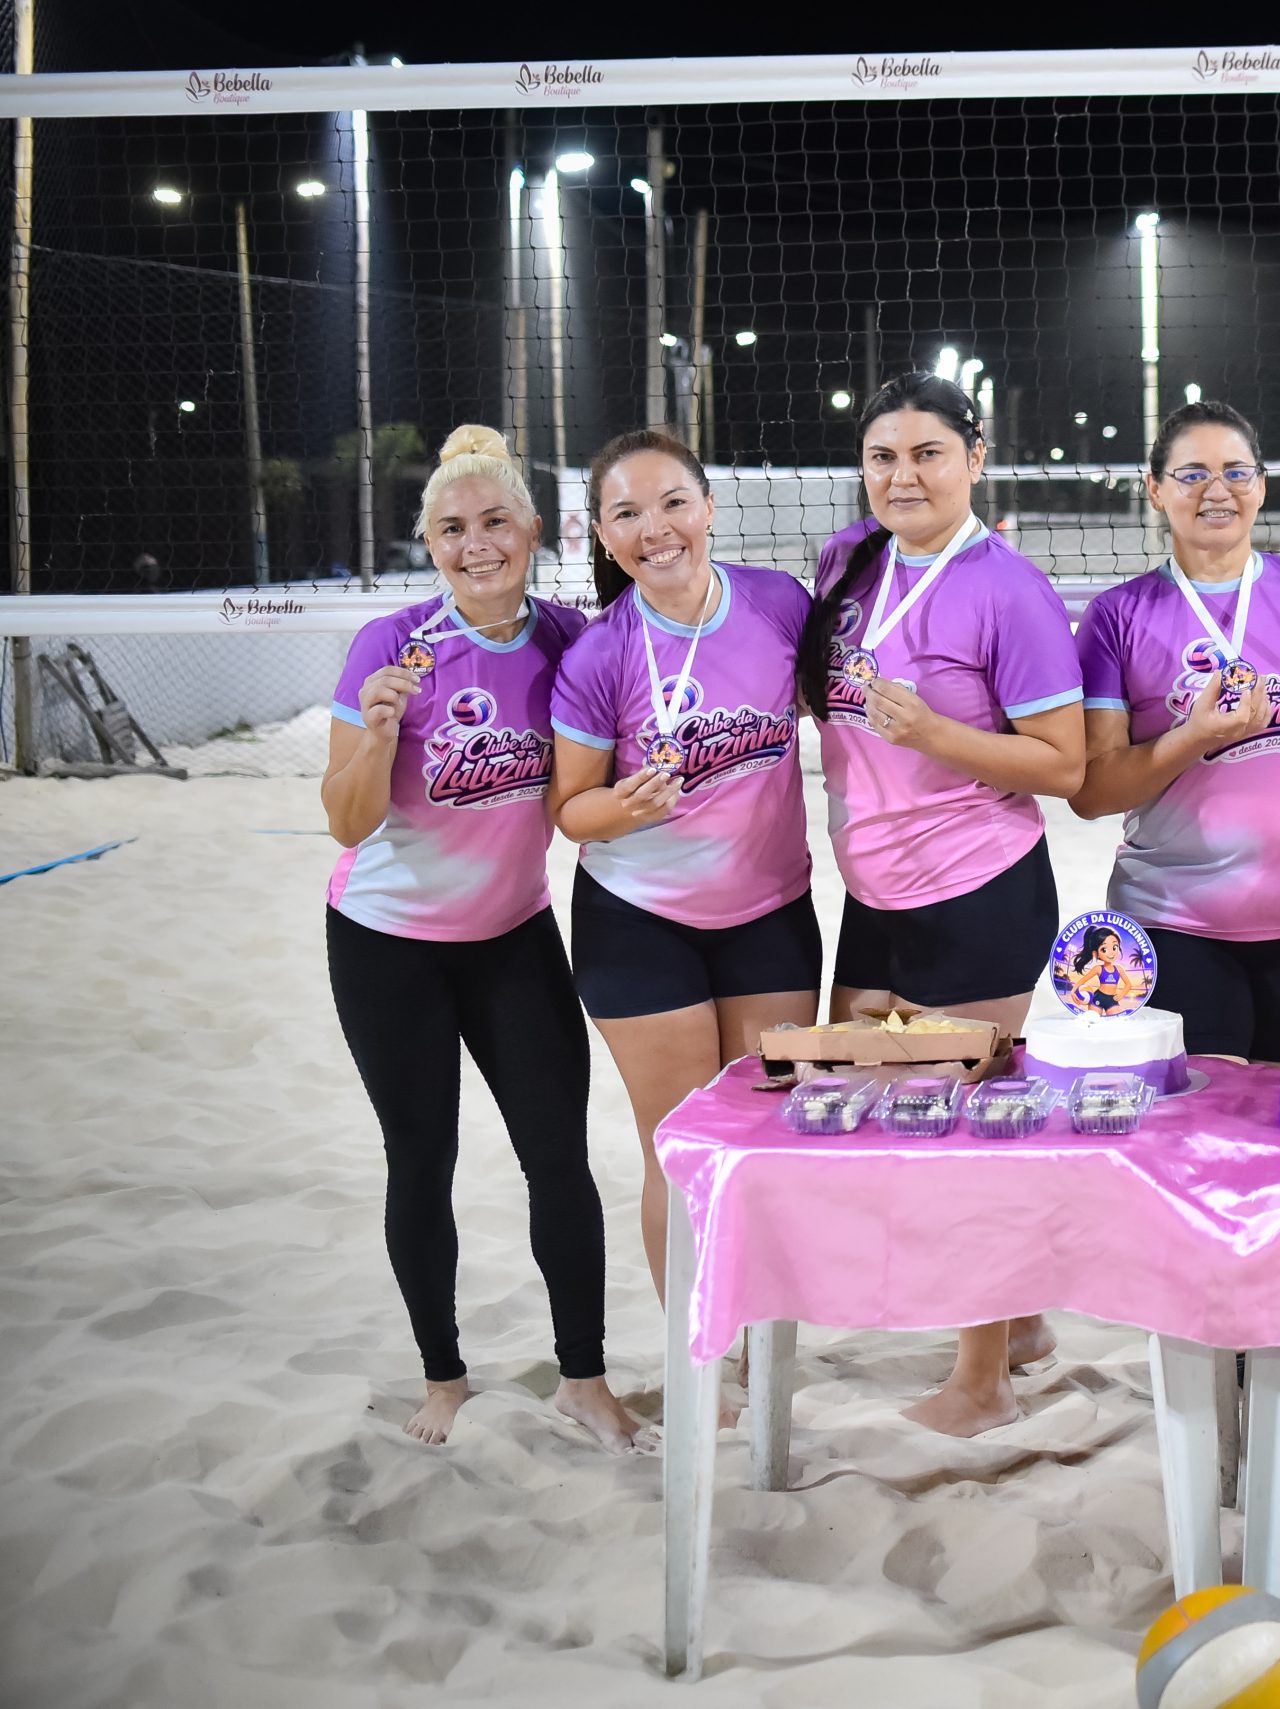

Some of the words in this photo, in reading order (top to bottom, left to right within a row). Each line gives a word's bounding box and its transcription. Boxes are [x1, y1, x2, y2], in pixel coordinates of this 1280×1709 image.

[544, 64, 604, 84] Bebella
[881, 57, 942, 77] Bebella
[213, 72, 273, 92] Bebella
[880, 78, 918, 91] Boutique
[212, 93, 250, 106] Boutique
[543, 85, 581, 99] Boutique
[247, 599, 306, 615] Bebella
[676, 711, 735, 746] Clube
[735, 709, 756, 727] da
[464, 731, 520, 760] Clube
[520, 733, 539, 750] da
[1238, 739, 1262, 755] desde
[739, 759, 764, 772] 2024
[490, 791, 515, 804] desde
[517, 787, 540, 797] 2024
[1061, 917, 1089, 943] CLUBE
[1090, 914, 1105, 924] DA
[1107, 914, 1151, 956] LULUZINHA
